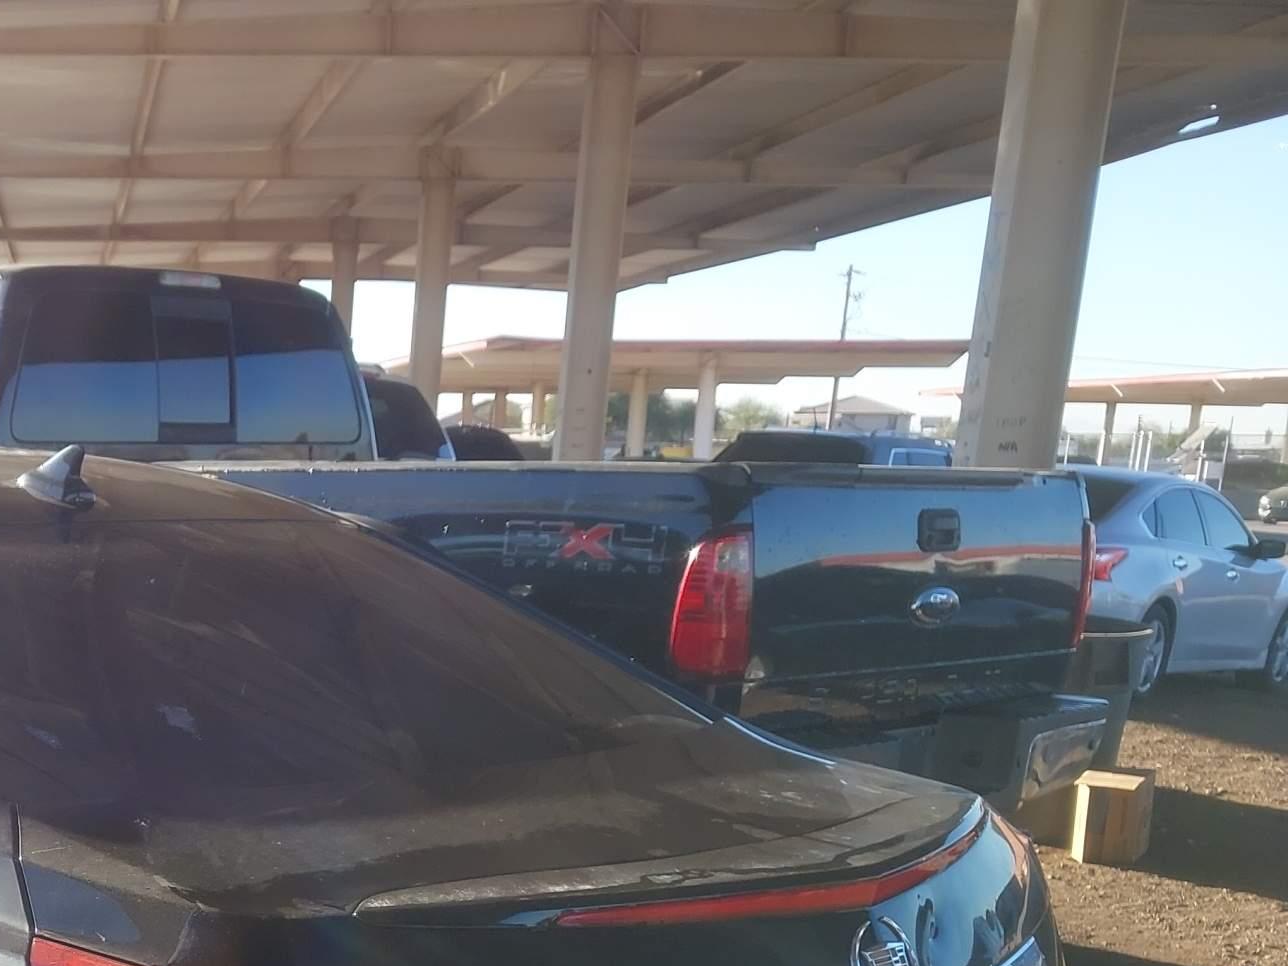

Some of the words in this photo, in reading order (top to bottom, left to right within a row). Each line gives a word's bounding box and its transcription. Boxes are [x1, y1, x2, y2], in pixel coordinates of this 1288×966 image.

[503, 520, 668, 562] FX4
[503, 558, 556, 568] OFF
[573, 560, 662, 574] ROAD
